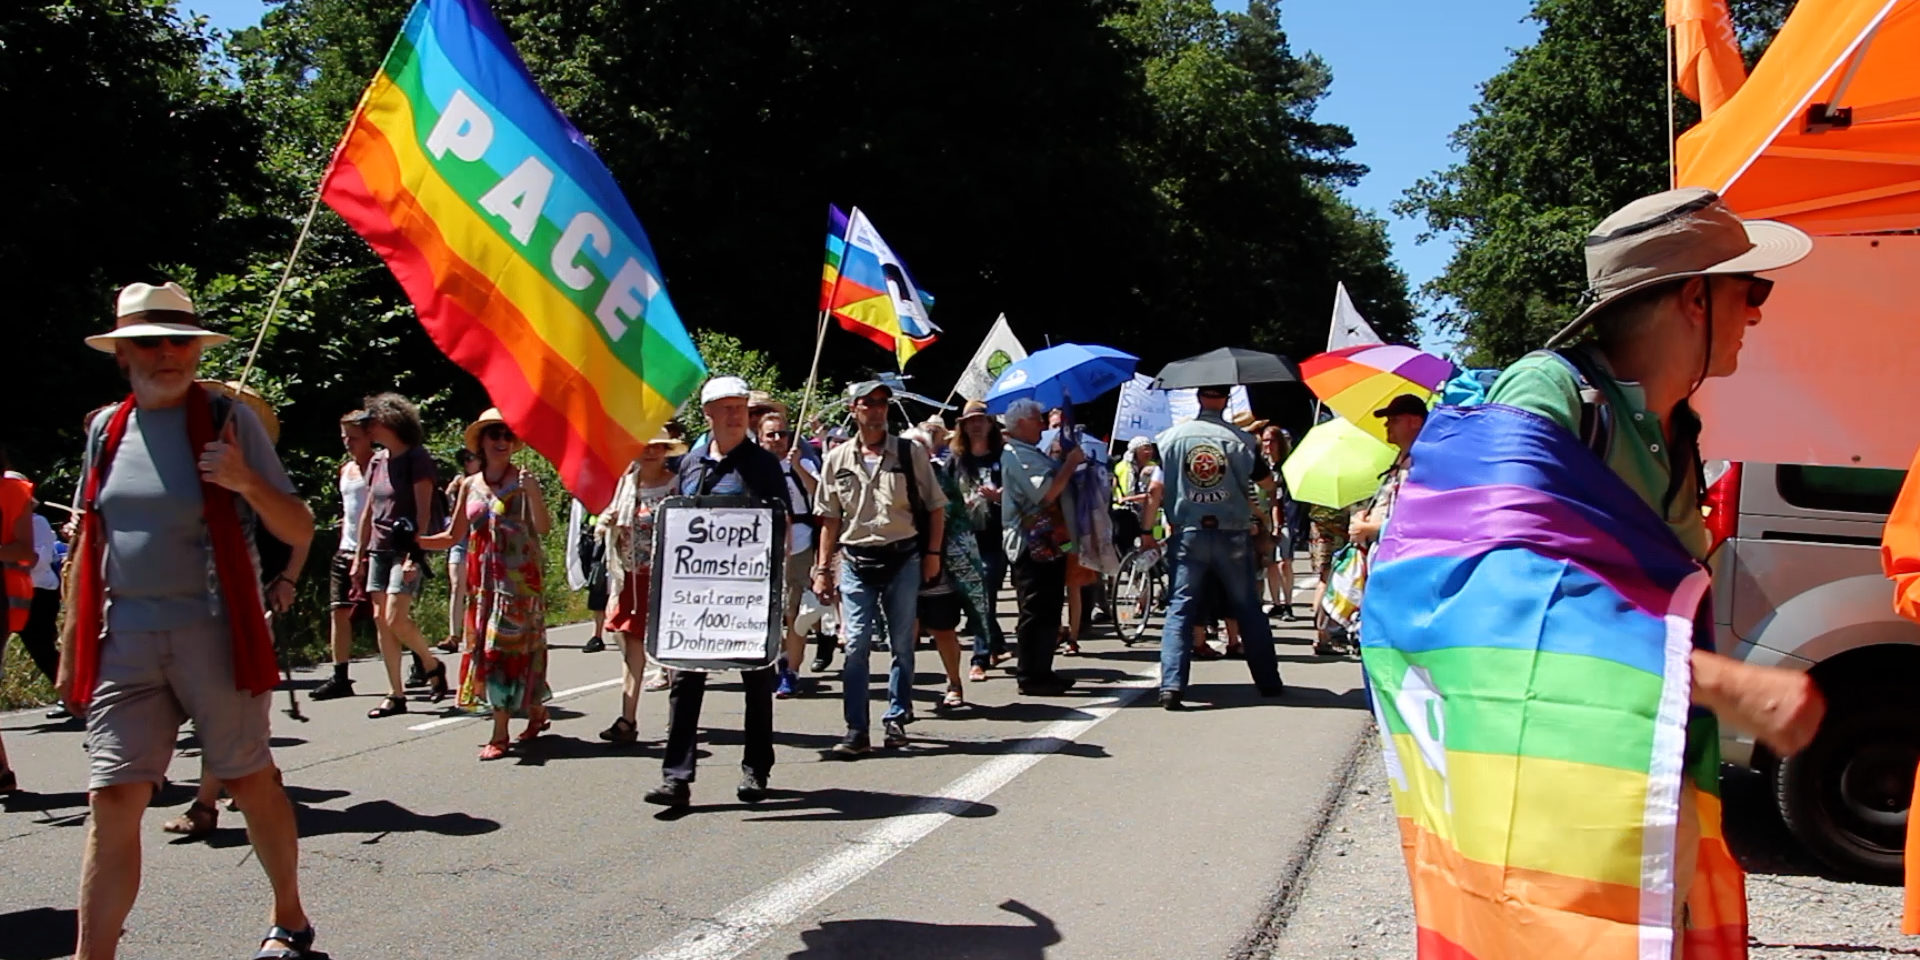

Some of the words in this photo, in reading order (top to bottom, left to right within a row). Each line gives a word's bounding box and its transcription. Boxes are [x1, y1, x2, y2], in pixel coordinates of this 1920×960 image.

[425, 89, 660, 342] PACE
[686, 514, 763, 547] Stoppt
[674, 545, 770, 577] Ramstein!
[672, 589, 764, 609] Startrampe
[668, 612, 686, 627] für
